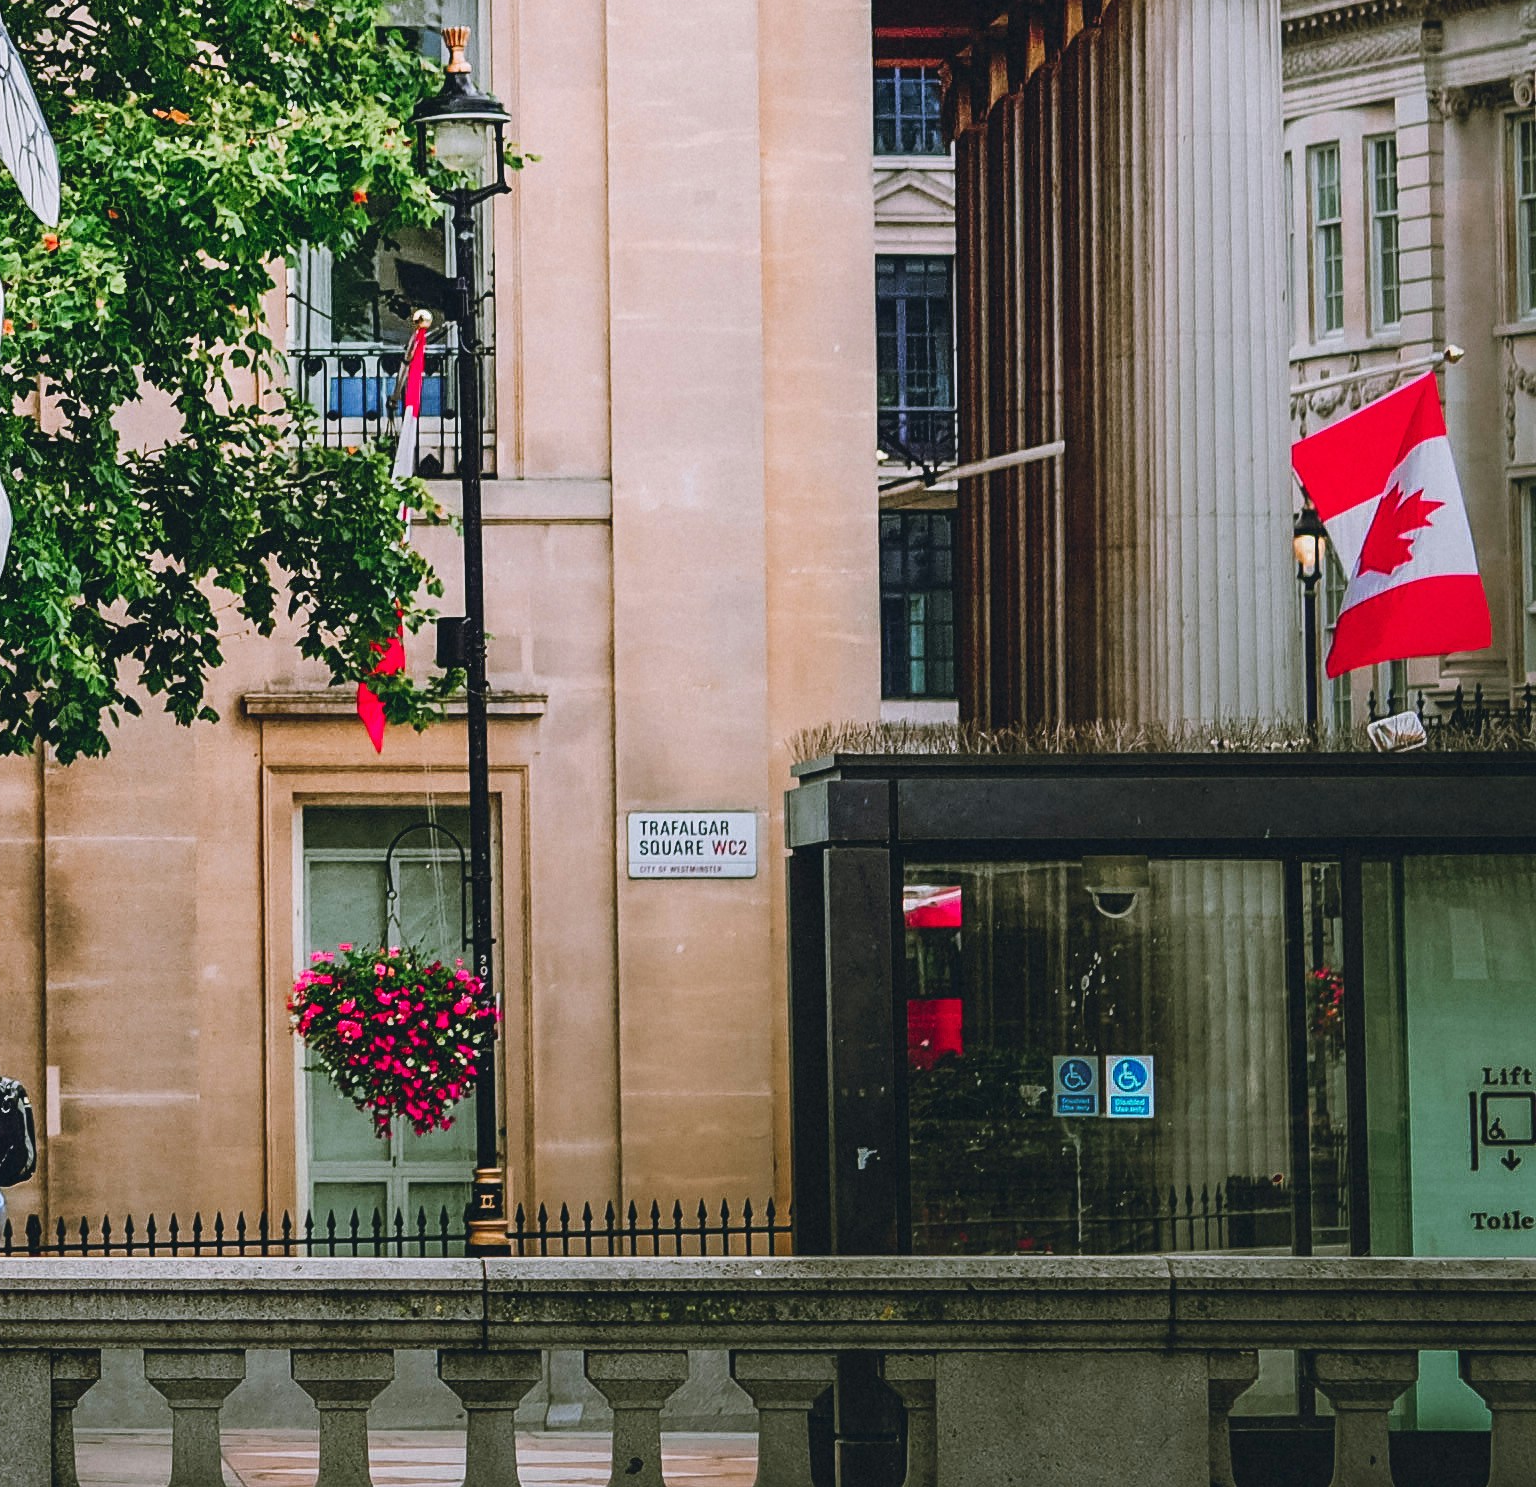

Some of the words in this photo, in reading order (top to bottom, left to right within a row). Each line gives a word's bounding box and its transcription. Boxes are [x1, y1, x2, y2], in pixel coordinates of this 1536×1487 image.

[639, 820, 729, 836] TRAFALGAR
[639, 840, 704, 856] SQUARE
[712, 840, 748, 856] WC2
[1482, 1066, 1532, 1085] Lift
